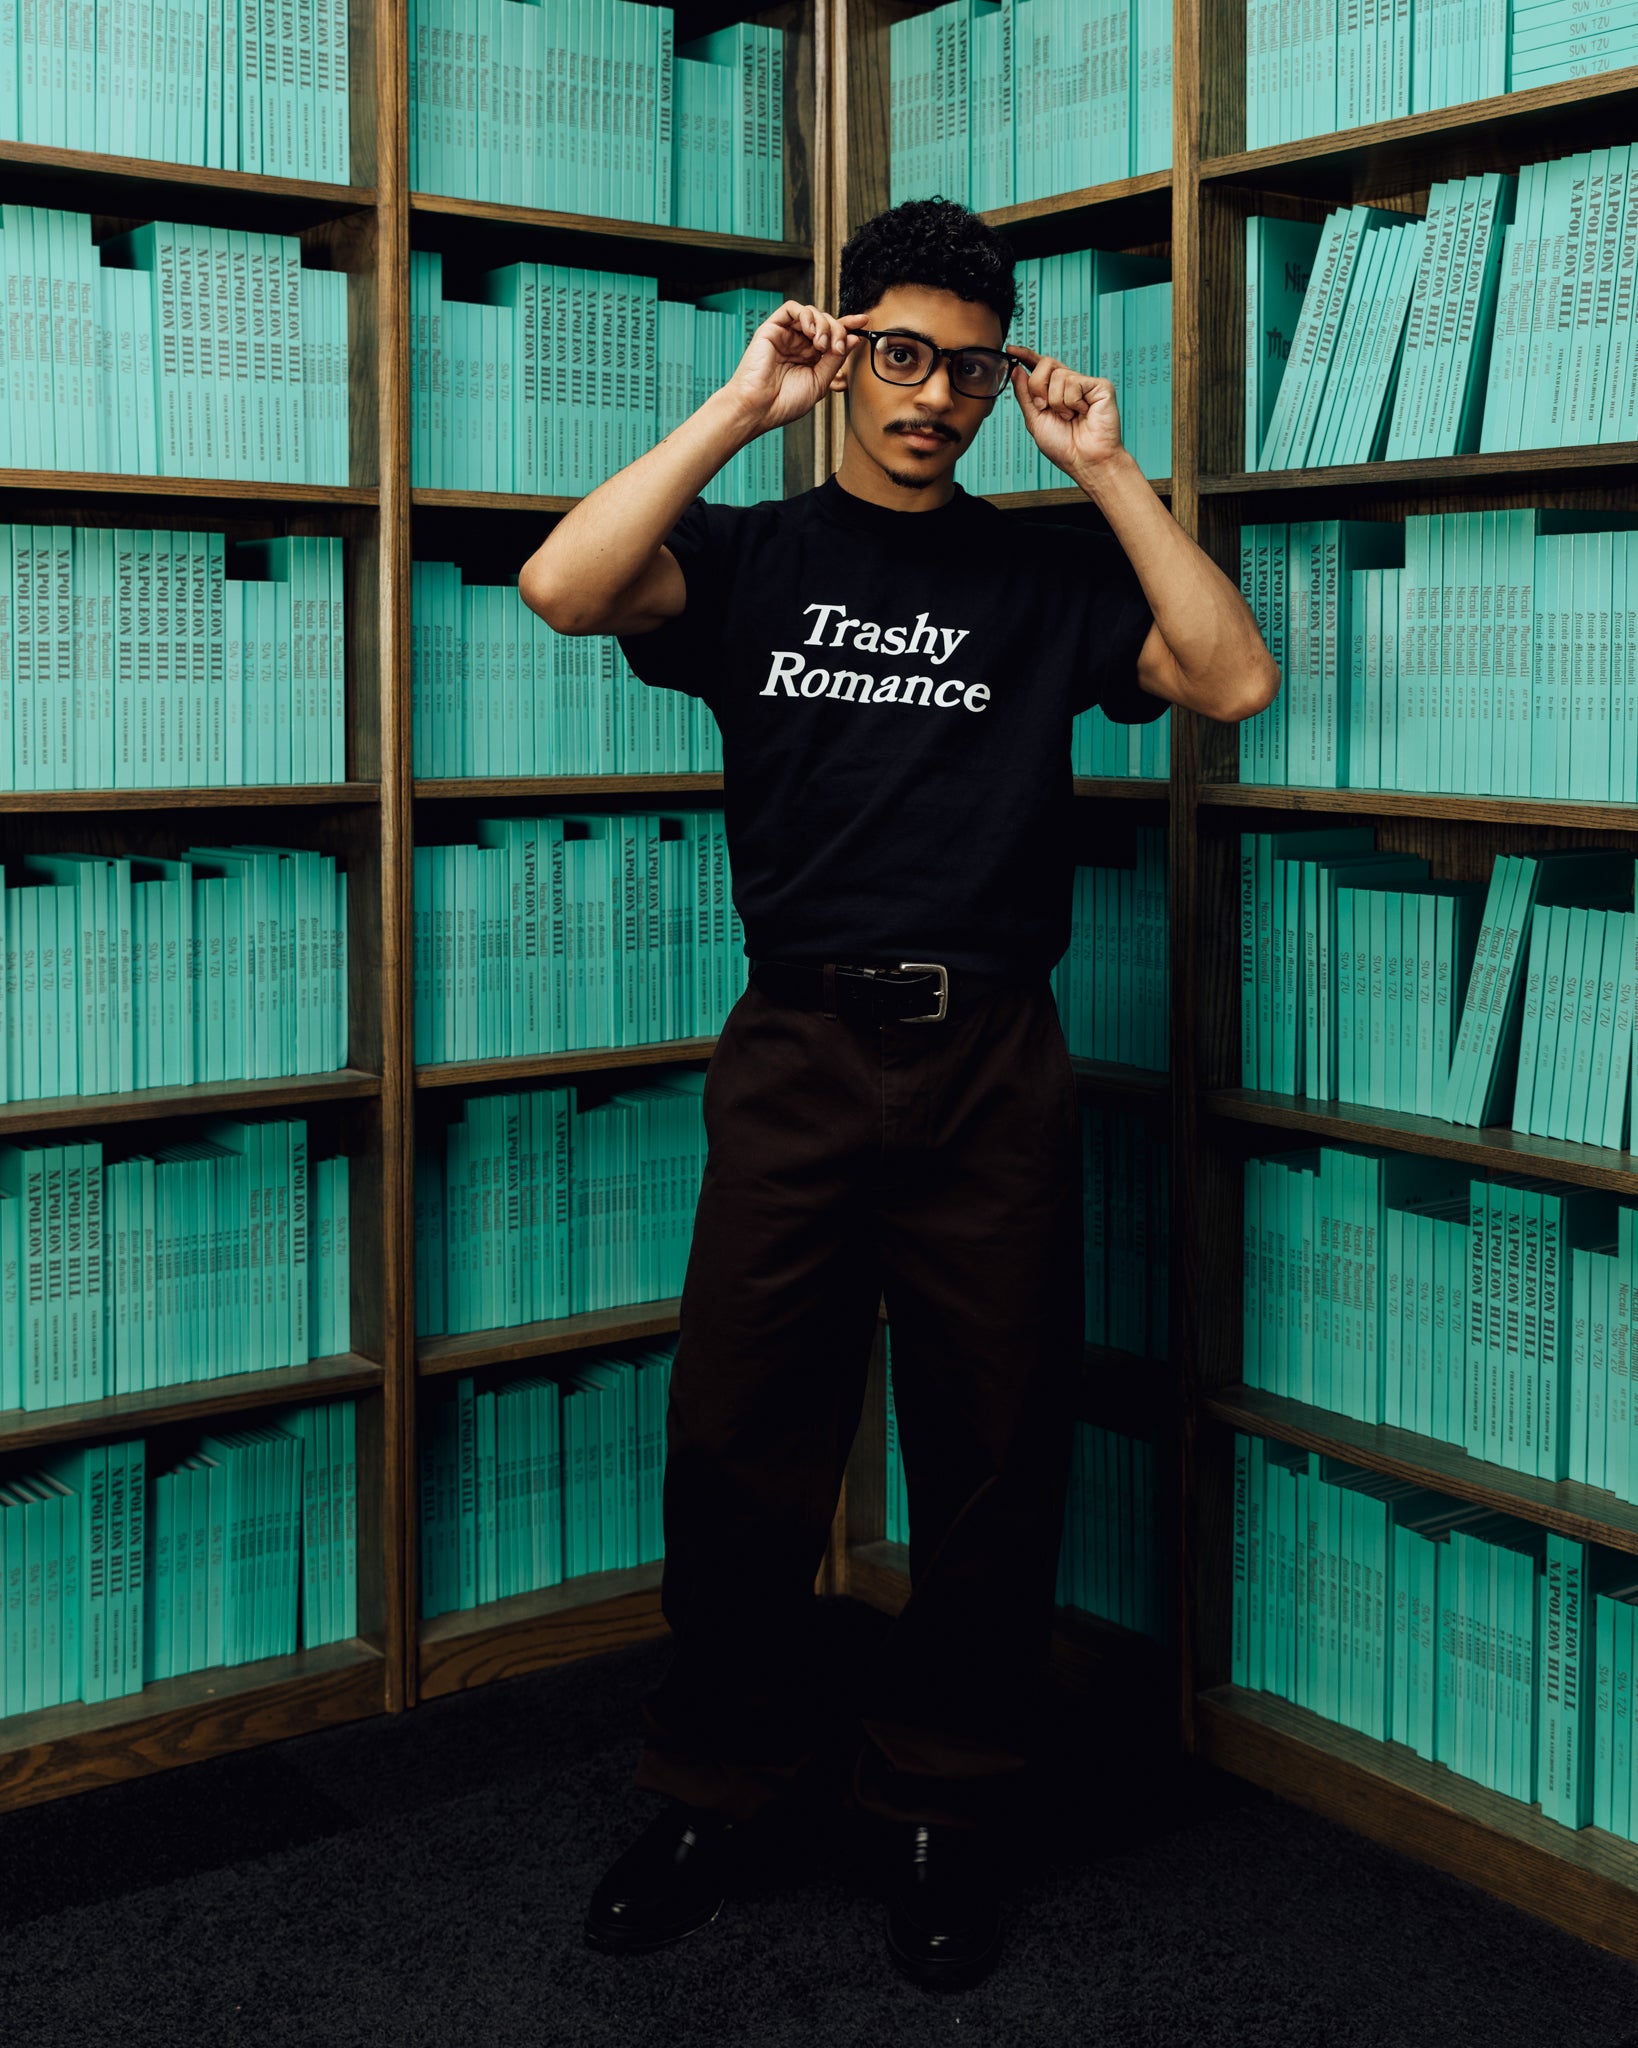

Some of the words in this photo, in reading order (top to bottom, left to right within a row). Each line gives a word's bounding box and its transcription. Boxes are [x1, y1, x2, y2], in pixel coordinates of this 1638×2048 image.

[1570, 22, 1587, 36] SUN
[1592, 16, 1610, 30] TZU
[1572, 1, 1589, 14] SUN
[661, 28, 672, 101] NAPOLEON
[1569, 44, 1586, 57] SUN
[1591, 38, 1609, 51] TZU
[757, 46, 767, 118] NAPOLEON
[1570, 65, 1587, 78] SUN
[1592, 59, 1610, 72] TZU
[660, 107, 670, 144] HILL
[757, 123, 767, 159] HILL
[1563, 180, 1584, 277] NAPOLEON
[1582, 177, 1603, 274] NAPOLEON
[1601, 174, 1622, 272] NAPOLEON
[1415, 209, 1440, 300] NAPOLEON
[1449, 202, 1474, 296] NAPOLEON
[1511, 242, 1524, 276] Niccolo
[1539, 238, 1551, 272] Niccolo
[1552, 235, 1565, 270] Niccolo
[160, 245, 175, 329] NAPOLEON
[233, 253, 247, 335] NAPOLEON
[1329, 230, 1359, 318] NAPOLEON
[287, 259, 299, 339] NAPOLEON
[1506, 283, 1521, 336] Machiavelli
[1533, 279, 1547, 332] Machiavelli
[1546, 276, 1560, 329] Machiavelli
[1557, 285, 1574, 332] HILL
[1576, 282, 1593, 329] HILL
[1595, 280, 1611, 328] HILL
[524, 284, 535, 360] NAPOLEON
[556, 287, 566, 362] NAPOLEON
[587, 291, 596, 365] NAPOLEON
[616, 294, 626, 368] NAPOLEON
[1407, 307, 1424, 352] HILL
[1441, 301, 1457, 348] HILL
[163, 335, 176, 376] HILL
[235, 341, 248, 382] HILL
[288, 345, 300, 385] HILL
[1316, 323, 1335, 367] HILL
[525, 365, 535, 403] HILL
[556, 368, 566, 405] HILL
[587, 371, 596, 408] HILL
[616, 374, 625, 411] HILL
[17, 549, 30, 634] NAPOLEON
[57, 550, 70, 634] NAPOLEON
[119, 552, 132, 635] NAPOLEON
[156, 553, 169, 636] NAPOLEON
[210, 555, 222, 637] NAPOLEON
[1310, 544, 1320, 630] NAPOLEON
[1326, 544, 1336, 630] NAPOLEON
[1468, 585, 1479, 619] Niccolo
[1496, 585, 1506, 618] Niccolo
[1520, 585, 1531, 619] Niccolo
[803, 603, 970, 665] Trashy
[1354, 635, 1362, 653] SUN
[1384, 635, 1393, 653] SUN
[1575, 613, 1585, 640] Niccolo
[1628, 612, 1637, 638] Niccolo
[18, 641, 31, 683] HILL
[57, 641, 70, 682] HILL
[120, 642, 131, 682] HILL
[156, 642, 169, 683] HILL
[210, 643, 222, 683] HILL
[278, 642, 287, 659] SUN
[1309, 636, 1320, 678] HILL
[1325, 637, 1335, 679] HILL
[1354, 658, 1362, 678] TZU
[1384, 658, 1392, 678] TZU
[1468, 624, 1479, 676] Machiavelli
[1495, 624, 1505, 676] Machiavelli
[1520, 625, 1531, 678] Machiavelli
[1574, 643, 1585, 685] Machiavelli
[1627, 642, 1637, 685] Machiavelli
[278, 664, 287, 681] TZU
[759, 651, 991, 712] Romance
[525, 841, 535, 916] NAPOLEON
[624, 838, 635, 912] NAPOLEON
[713, 833, 723, 904] NAPOLEON
[1242, 856, 1253, 939] NAPOLEON
[525, 922, 536, 960] HILL
[625, 917, 636, 952] HILL
[714, 909, 724, 946] HILL
[1490, 926, 1505, 958] Niccolo
[1503, 928, 1519, 960] Niccolo
[166, 941, 176, 959] SUN
[1242, 945, 1253, 985] HILL
[1357, 953, 1366, 971] SUN
[1389, 957, 1397, 976] SUN
[166, 963, 176, 982] TZU
[1357, 976, 1366, 995] TZU
[1388, 981, 1397, 1000] TZU
[1438, 962, 1447, 981] SUN
[1479, 964, 1497, 1014] Machiavelli
[1491, 965, 1510, 1016] Machiavelli
[1529, 972, 1540, 993] SUN
[1566, 976, 1577, 997] SUN
[1602, 981, 1613, 1002] SUN
[1438, 986, 1447, 1006] TZU
[1527, 998, 1537, 1018] TZU
[1563, 1002, 1575, 1023] TZU
[1620, 984, 1631, 1004] SUN
[1600, 1007, 1611, 1028] TZU
[1617, 1009, 1629, 1031] TZU
[555, 1111, 566, 1184] NAPOLEON
[294, 1142, 305, 1221] NAPOLEON
[28, 1173, 42, 1256] NAPOLEON
[68, 1168, 81, 1251] NAPOLEON
[87, 1166, 100, 1249] NAPOLEON
[556, 1189, 566, 1225] HILL
[294, 1226, 305, 1266] HILL
[1471, 1205, 1484, 1295] NAPOLEON
[1507, 1213, 1520, 1305] NAPOLEON
[1543, 1220, 1556, 1313] NAPOLEON
[29, 1263, 42, 1304] HILL
[68, 1257, 81, 1298] HILL
[87, 1255, 100, 1295] HILL
[1436, 1285, 1445, 1304] SUN
[1436, 1310, 1444, 1328] TZU
[1619, 1283, 1629, 1317] Niccolo
[1471, 1301, 1482, 1345] HILL
[1506, 1311, 1518, 1354] HILL
[1542, 1318, 1555, 1363] HILL
[1575, 1318, 1585, 1339] SUN
[1593, 1323, 1603, 1343] SUN
[1574, 1344, 1584, 1365] TZU
[1593, 1349, 1603, 1369] TZU
[1618, 1323, 1629, 1376] Machiavelli
[91, 1470, 104, 1553] NAPOLEON
[129, 1463, 143, 1545] NAPOLEON
[91, 1558, 103, 1600] HILL
[129, 1550, 141, 1591] HILL
[1565, 1566, 1578, 1660] NAPOLEON
[1564, 1665, 1576, 1710] HILL
